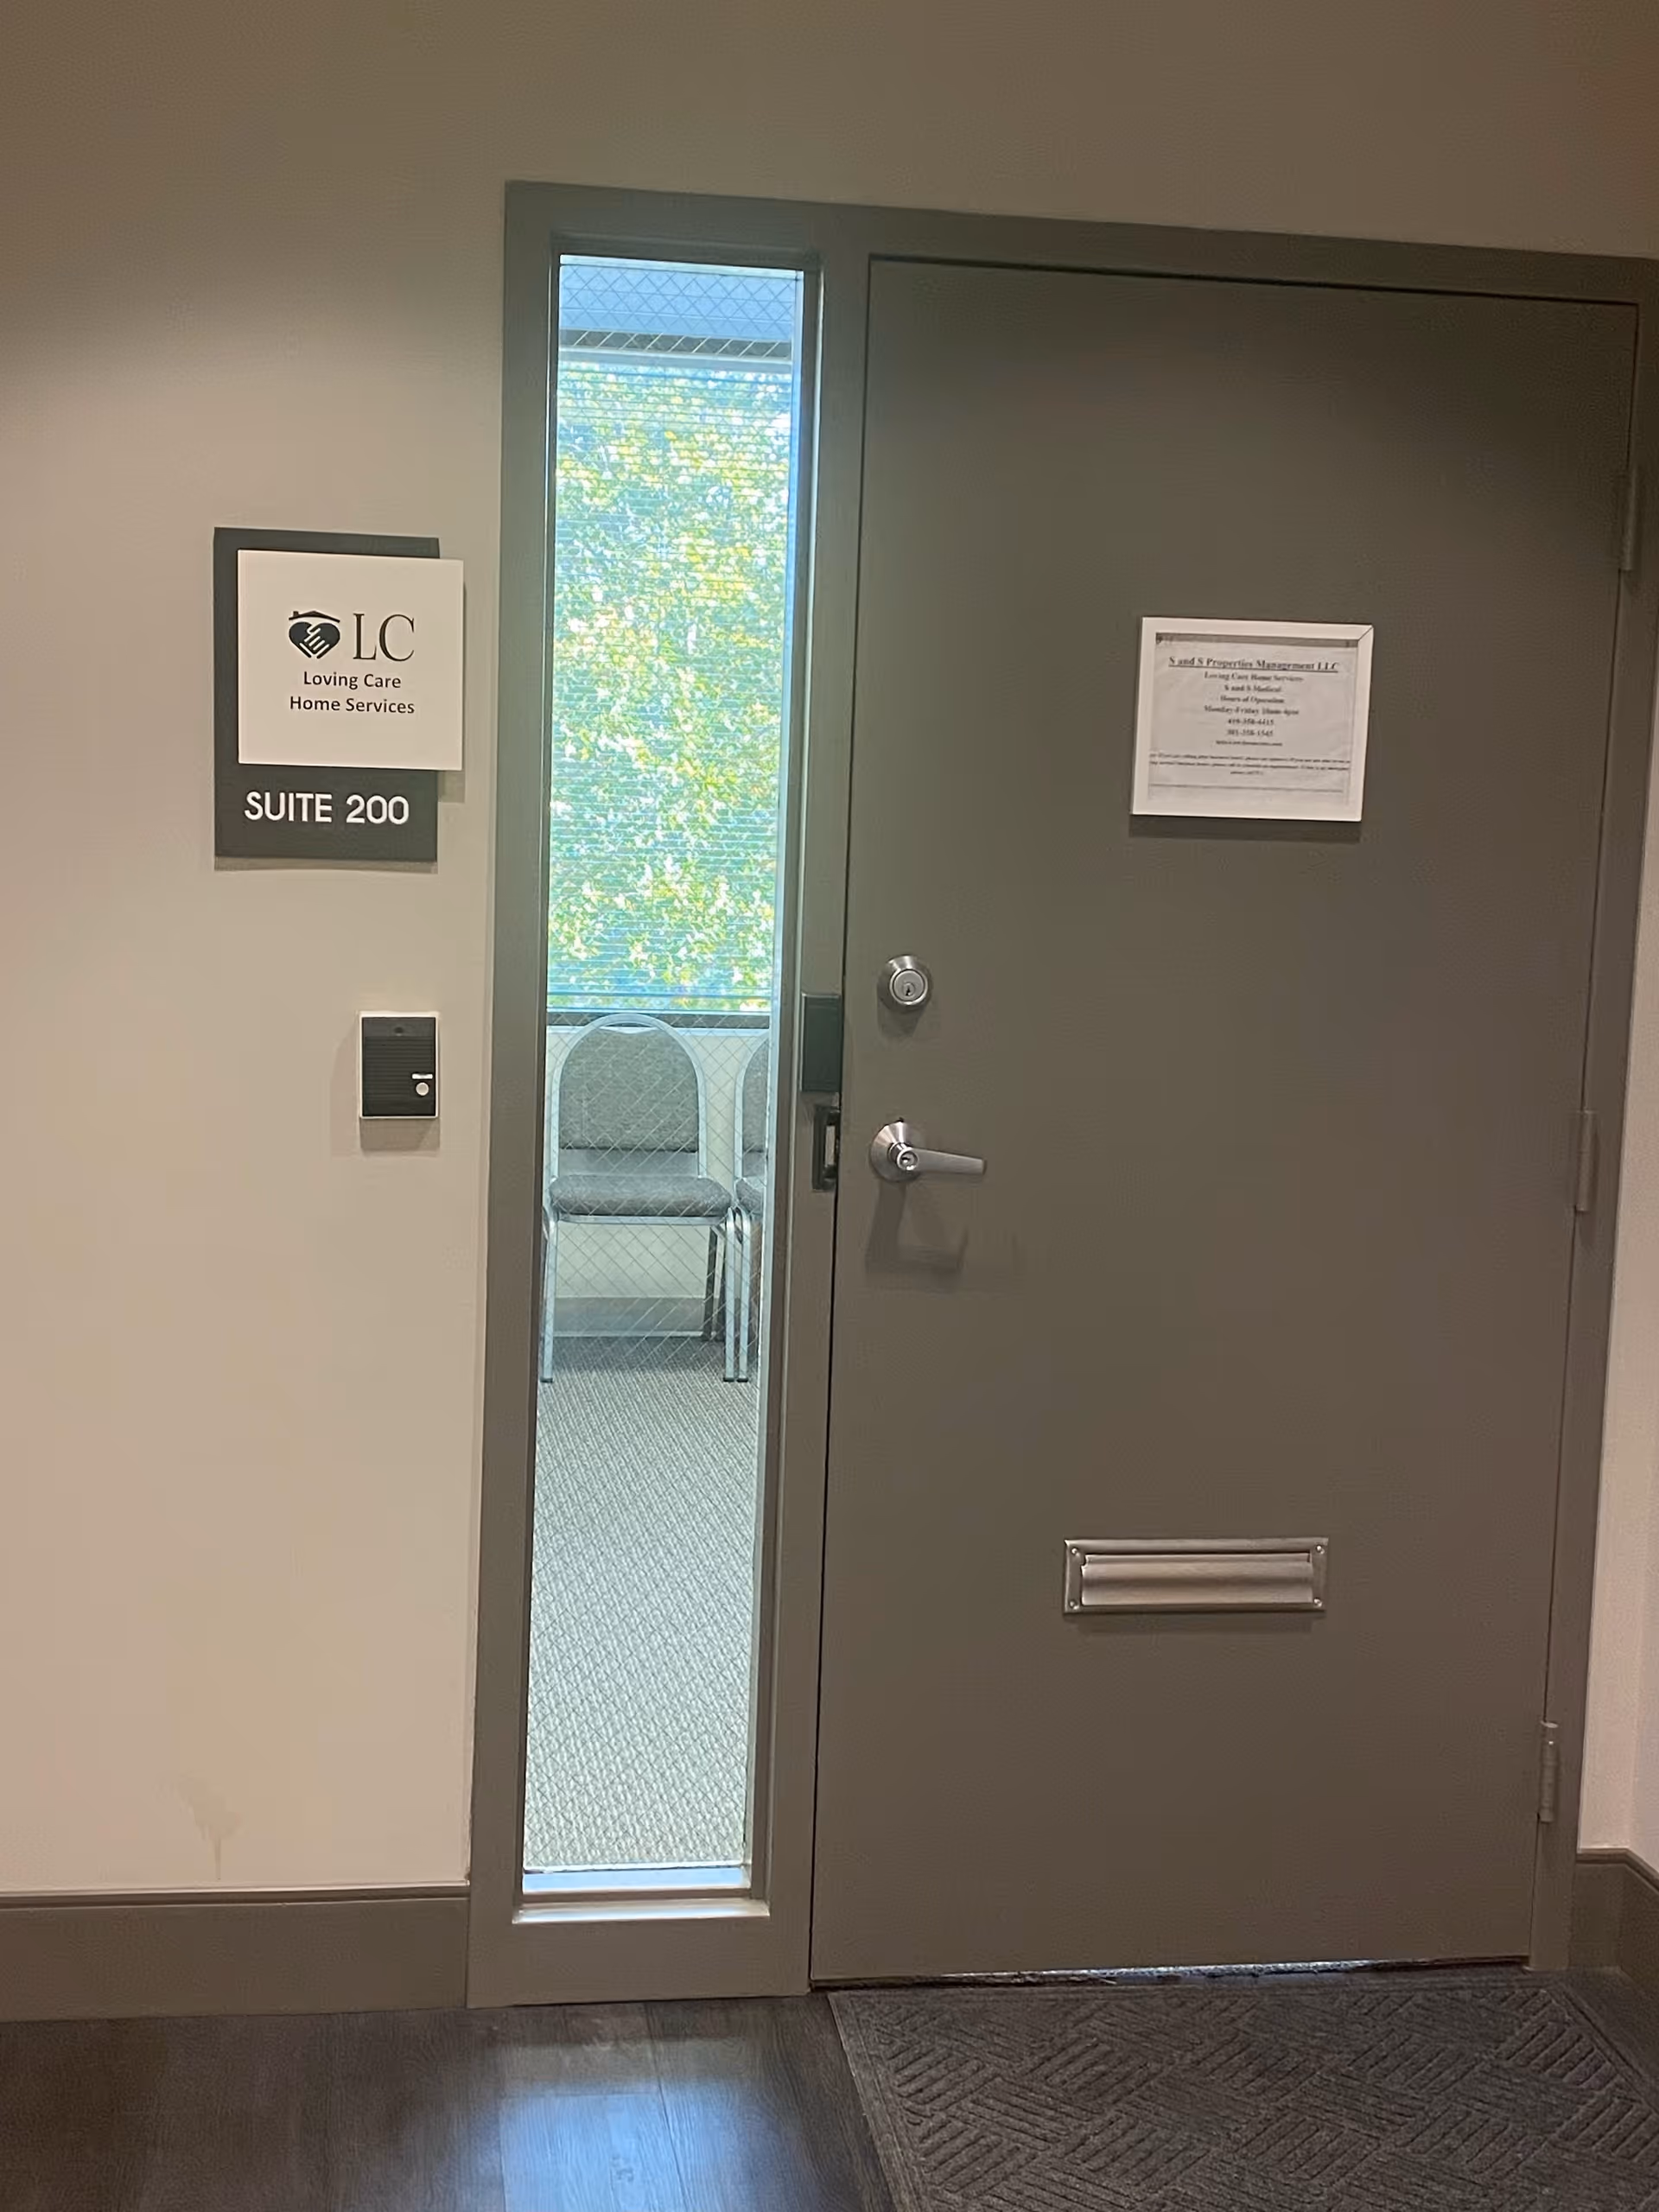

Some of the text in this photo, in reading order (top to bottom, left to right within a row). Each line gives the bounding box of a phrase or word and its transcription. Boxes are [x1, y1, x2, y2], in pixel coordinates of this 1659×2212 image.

[353, 613, 416, 662] LC
[1207, 658, 1253, 670] Properties
[1256, 660, 1315, 671] Management
[303, 671, 402, 690] Loving Care
[289, 696, 415, 715] Home Services
[244, 791, 410, 825] SUITE 200
